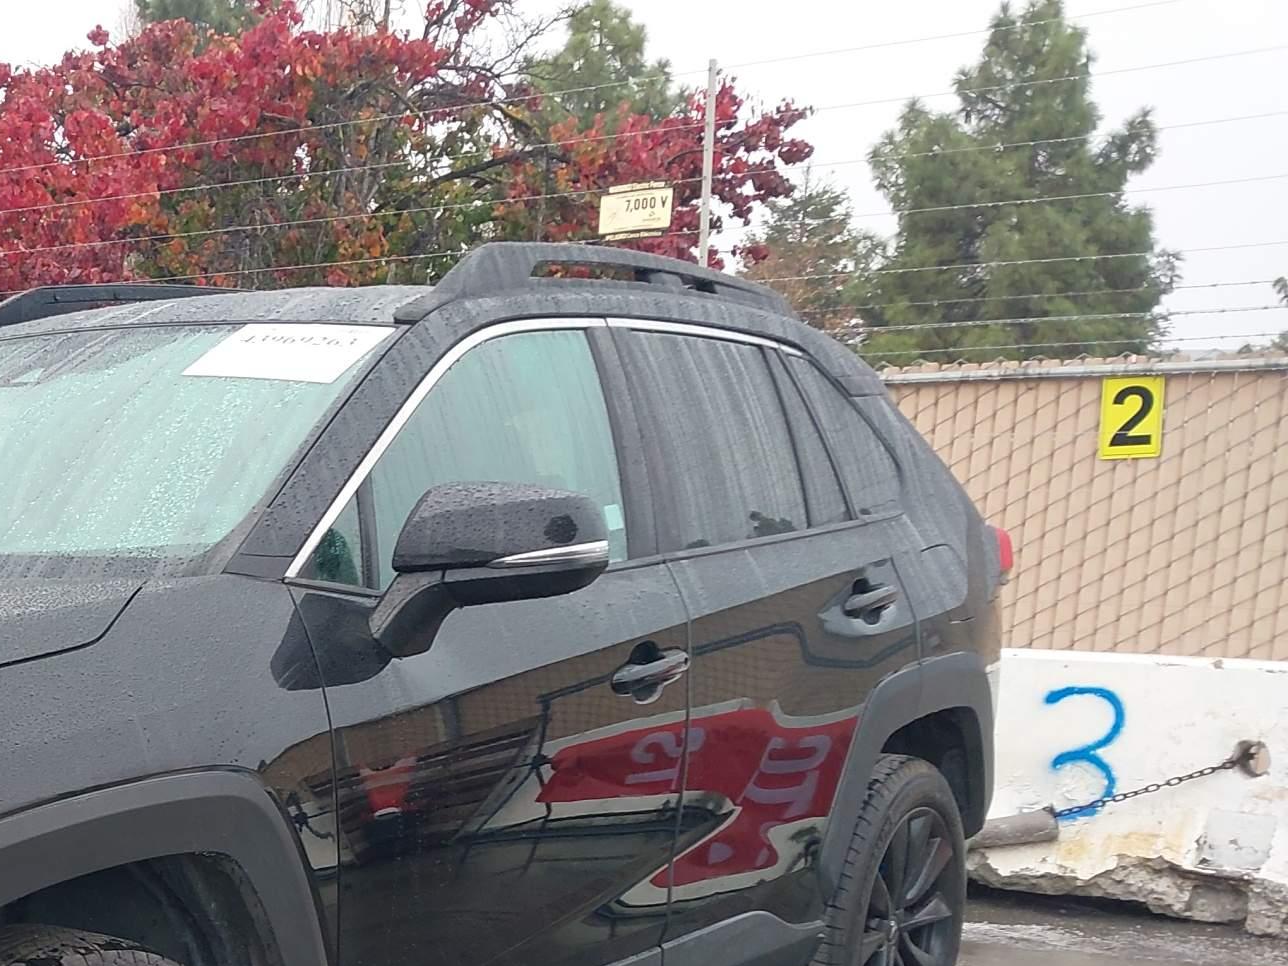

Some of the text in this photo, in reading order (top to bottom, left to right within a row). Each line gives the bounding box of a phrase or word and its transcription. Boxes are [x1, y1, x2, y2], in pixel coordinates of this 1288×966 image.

[625, 195, 669, 213] 7,000 V
[1107, 385, 1154, 448] 2
[1044, 685, 1125, 821] 3
